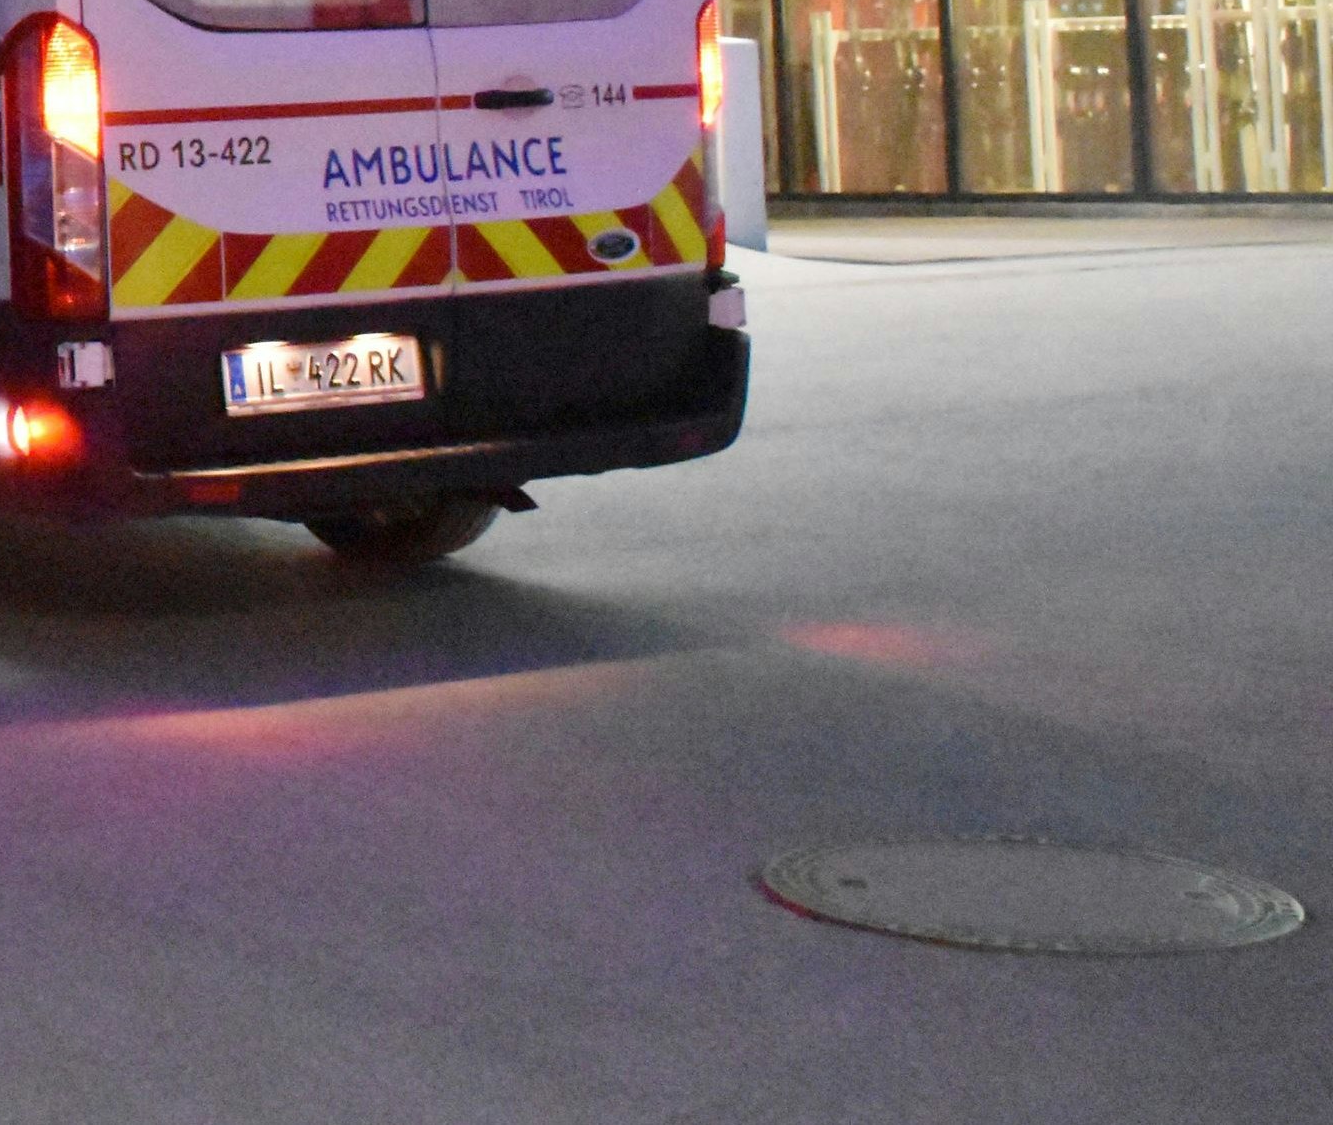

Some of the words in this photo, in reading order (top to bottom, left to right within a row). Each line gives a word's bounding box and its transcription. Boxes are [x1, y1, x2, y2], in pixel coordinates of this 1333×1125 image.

[591, 83, 626, 107] 144
[119, 140, 160, 171] RD
[171, 136, 271, 168] 13-422
[323, 136, 567, 189] AMBULANCE
[326, 191, 498, 222] RETTUNGSDIENST
[519, 187, 573, 209] TIROL
[257, 361, 284, 396] IL
[307, 351, 361, 391] 422
[368, 346, 405, 388] RK
